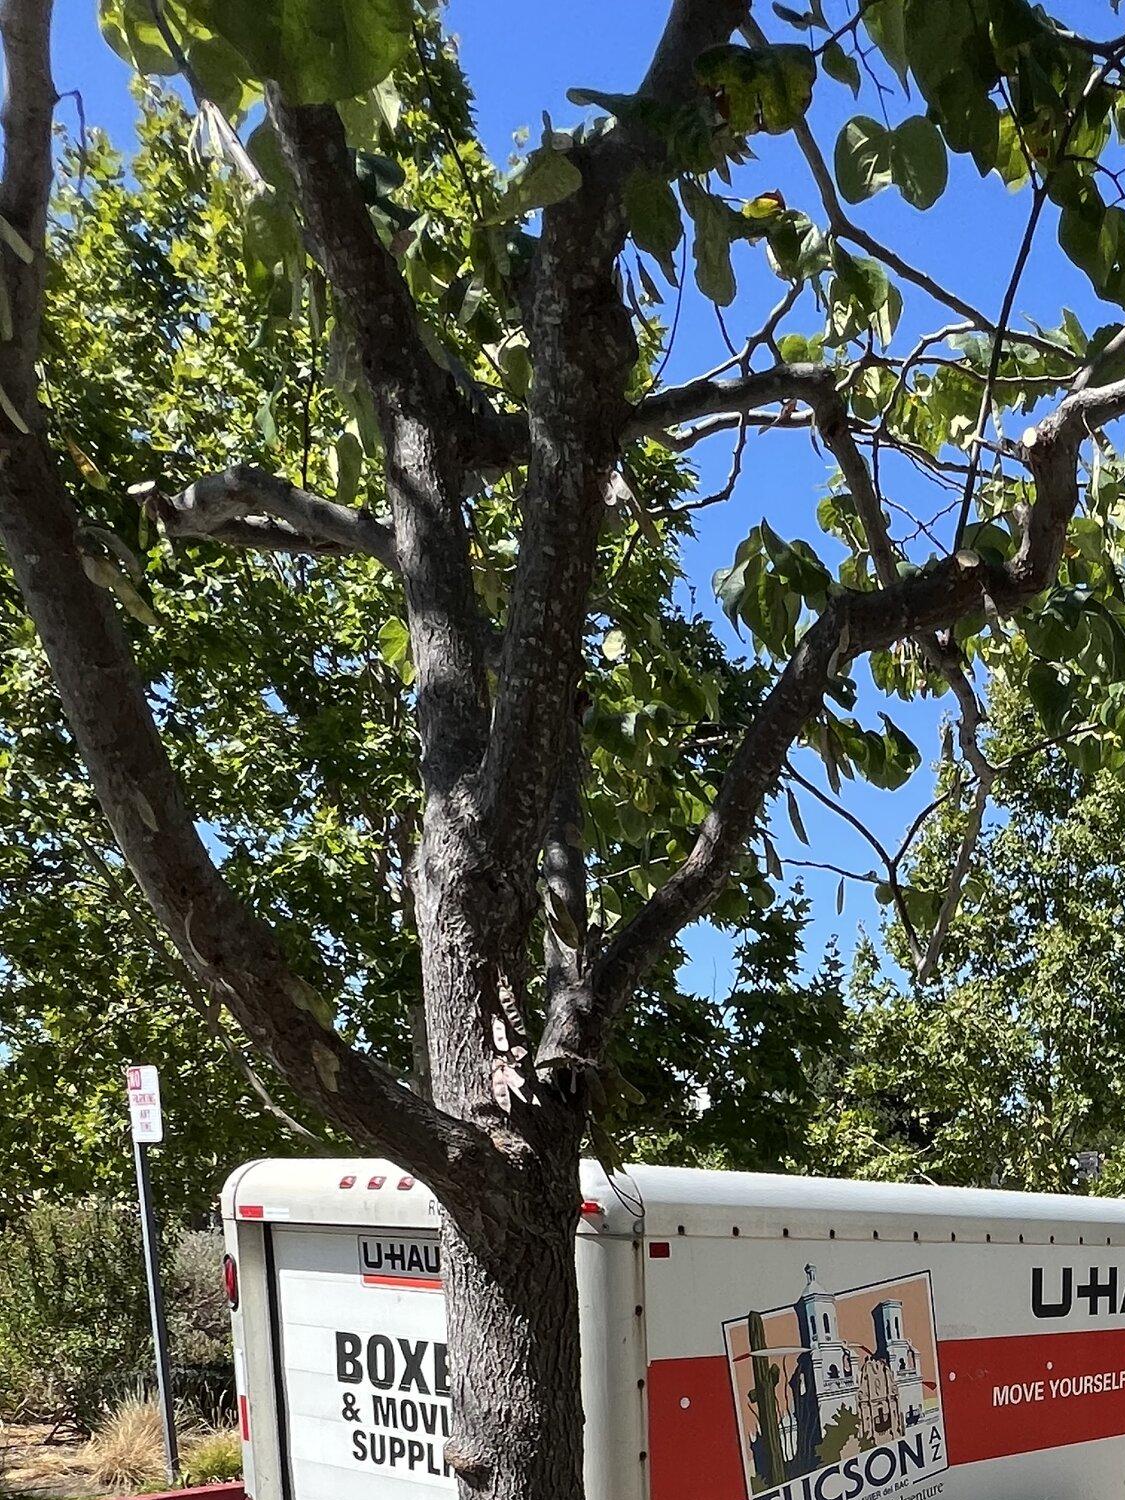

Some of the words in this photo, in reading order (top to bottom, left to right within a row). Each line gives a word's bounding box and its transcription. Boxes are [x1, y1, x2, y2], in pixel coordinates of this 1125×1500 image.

[362, 1241, 440, 1273] U-HAU
[335, 1331, 452, 1398] BOXE
[992, 1380, 1045, 1407] MOVE
[341, 1392, 362, 1423] &
[371, 1395, 451, 1438] MOVI
[352, 1429, 452, 1478] SUPPLI
[894, 1478, 910, 1492] BAC
